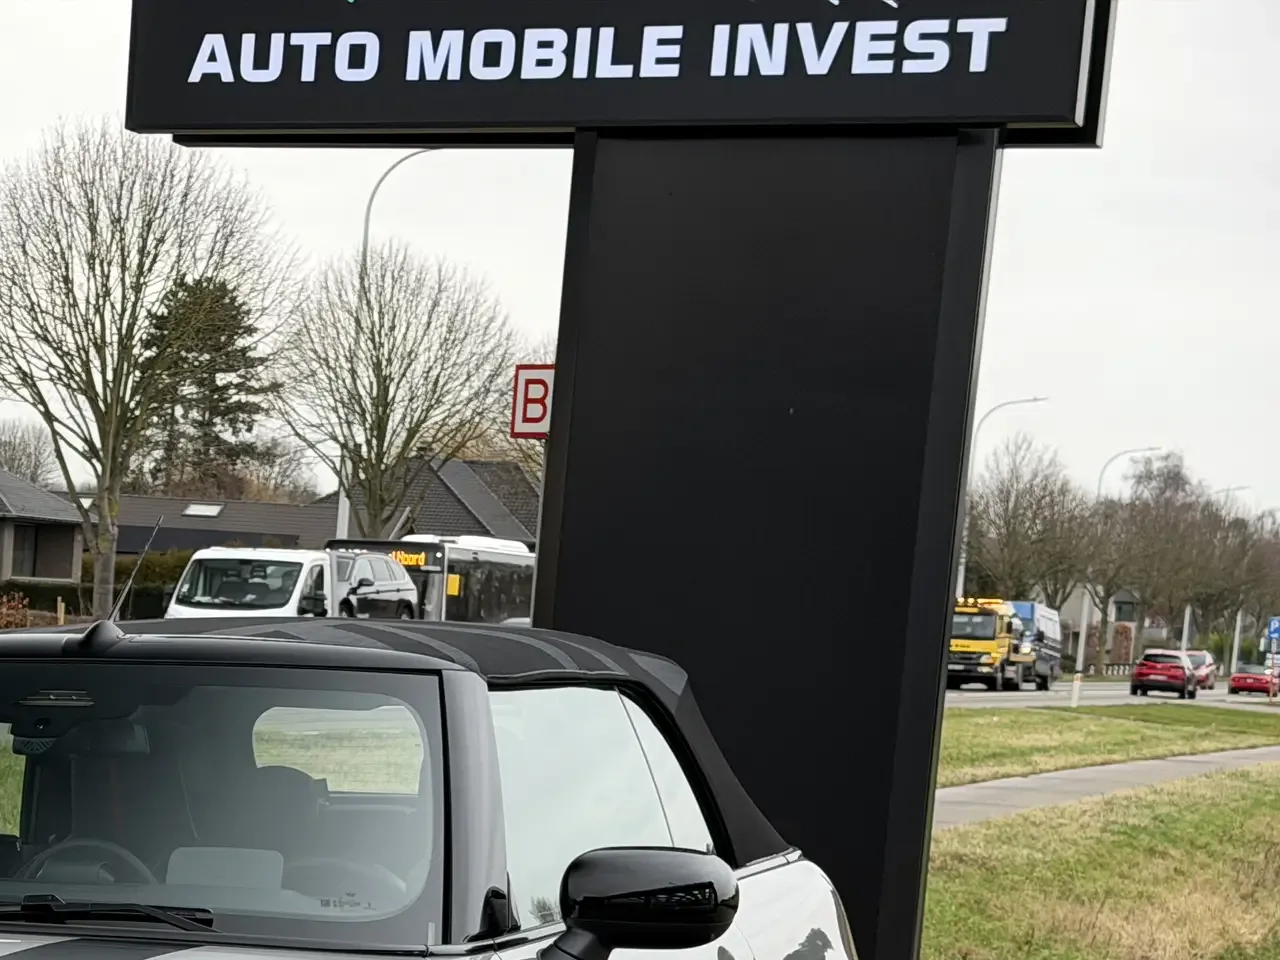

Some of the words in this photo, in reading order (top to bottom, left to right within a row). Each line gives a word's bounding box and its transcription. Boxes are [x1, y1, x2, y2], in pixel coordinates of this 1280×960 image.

[187, 31, 380, 83] AUTO
[405, 25, 684, 81] MOBILE
[710, 17, 1008, 76] INVEST
[522, 378, 549, 424] B
